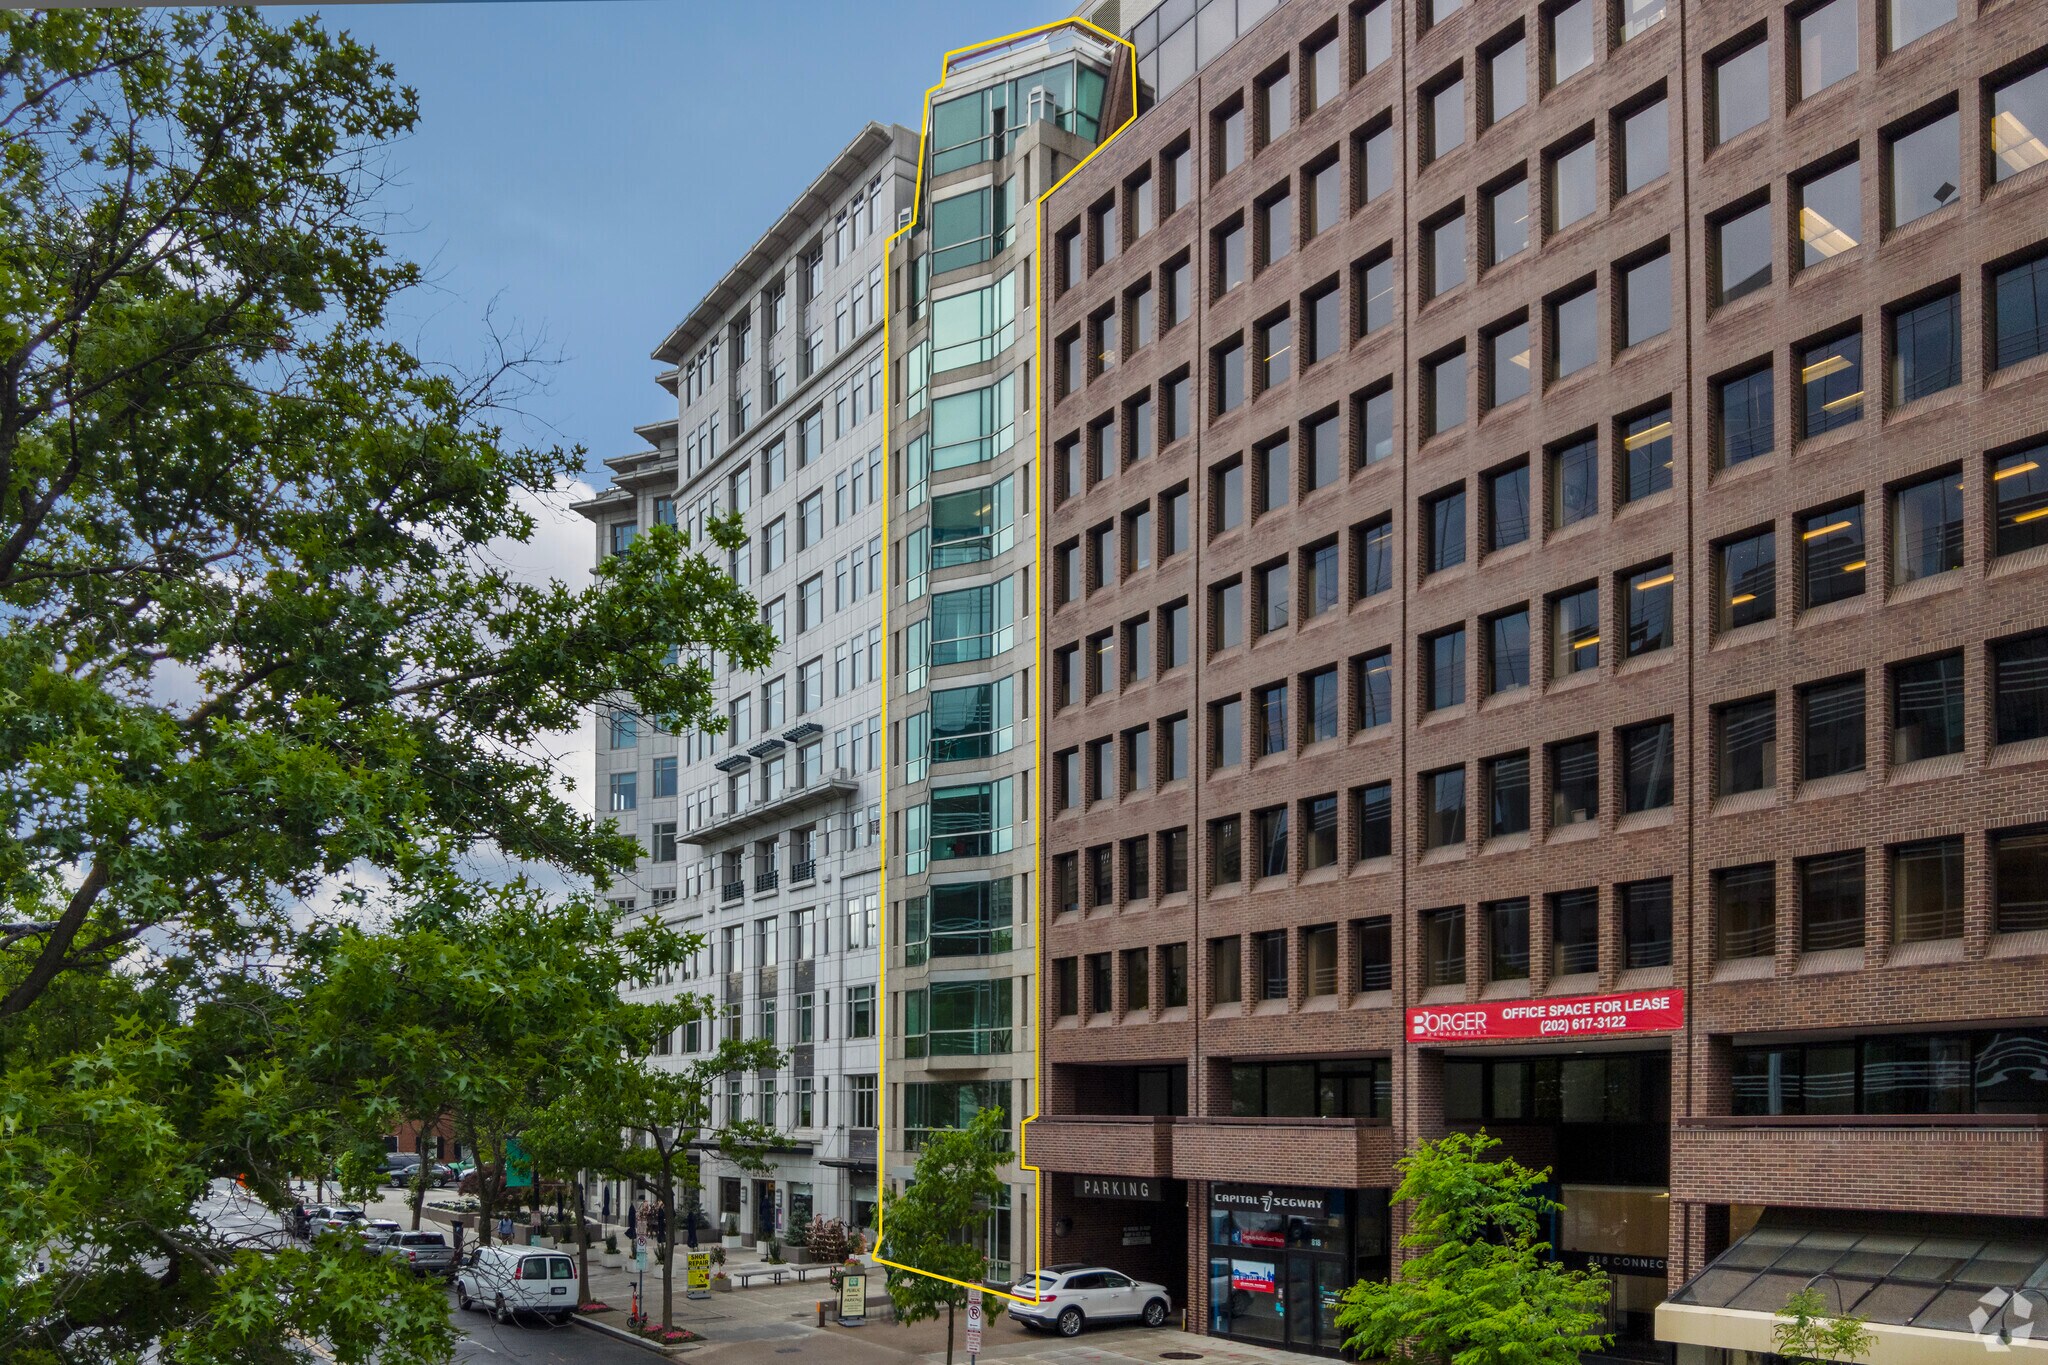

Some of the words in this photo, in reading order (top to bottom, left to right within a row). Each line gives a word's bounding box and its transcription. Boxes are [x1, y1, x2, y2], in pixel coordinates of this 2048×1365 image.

[1502, 1006, 1546, 1019] OFFICE
[1549, 1003, 1591, 1017] SPACE
[1594, 1000, 1622, 1014] FOR
[1625, 997, 1670, 1012] LEASE
[1413, 1011, 1487, 1035] BORGER
[1540, 1019, 1569, 1034] (202)
[1572, 1015, 1627, 1030] 617-3122
[1084, 1180, 1149, 1197] PARKING
[1215, 1194, 1259, 1204] CAPITAL
[1274, 1198, 1322, 1208] SEGWAY
[1588, 1255, 1608, 1265] 818
